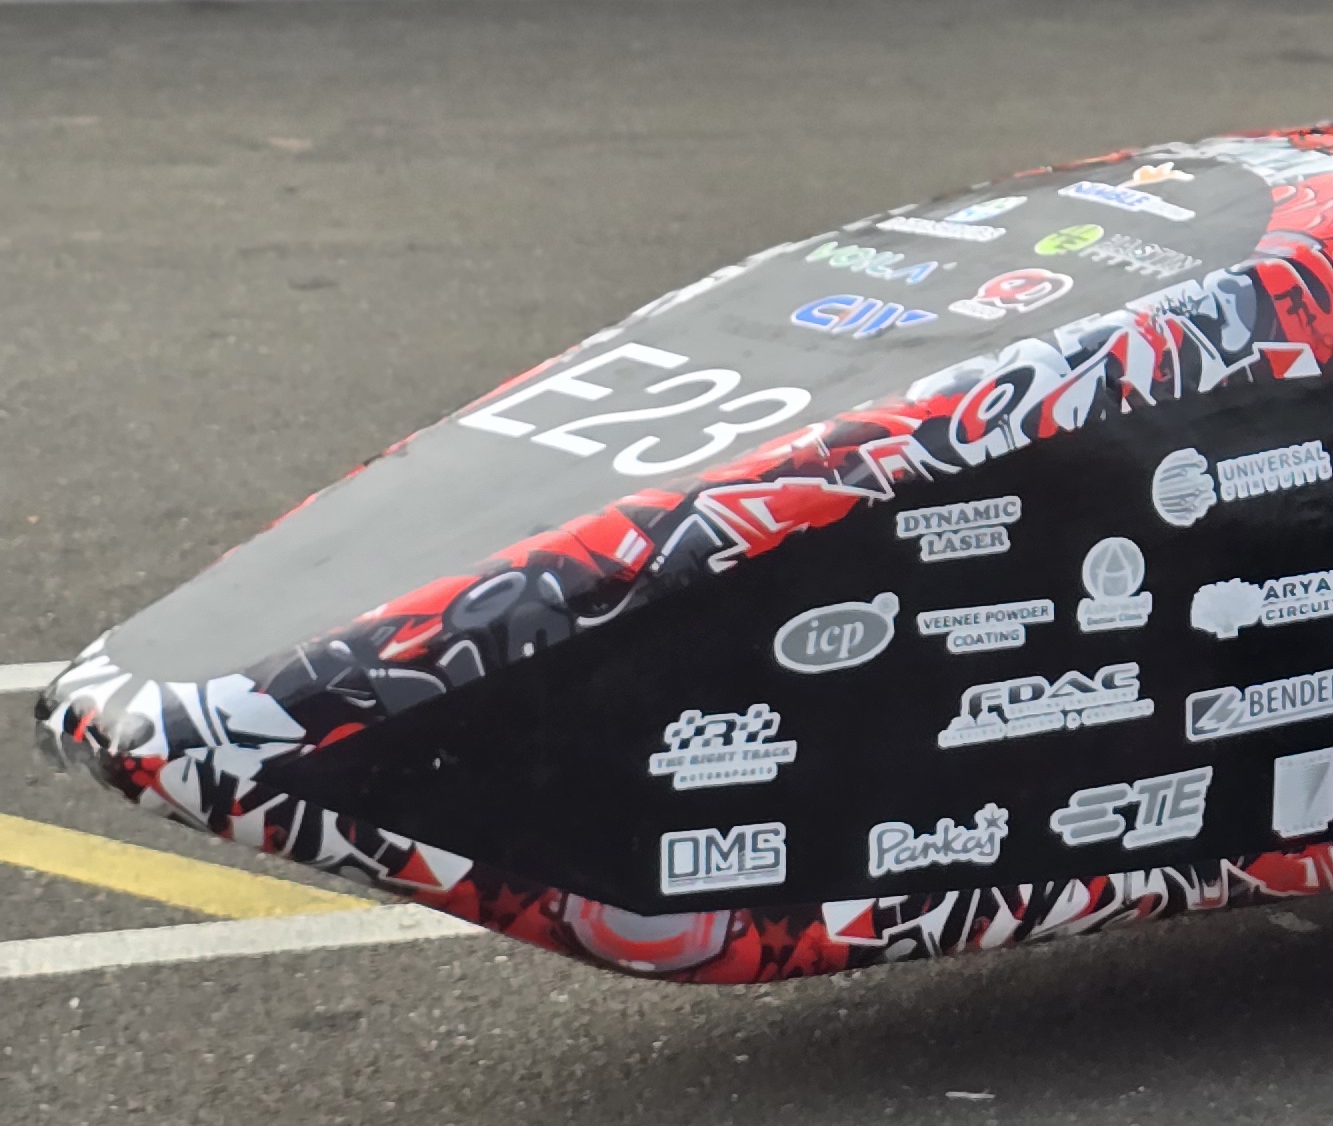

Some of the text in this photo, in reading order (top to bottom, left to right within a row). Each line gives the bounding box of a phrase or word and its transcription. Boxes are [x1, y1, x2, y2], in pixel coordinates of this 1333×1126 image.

[459, 342, 812, 476] E23
[1222, 446, 1327, 481] UNIVERSAL
[902, 500, 1018, 534] DYNAMIC
[926, 530, 1005, 557] LASER
[923, 604, 1050, 630] VEENEE POWDER
[805, 619, 865, 659] icp
[953, 628, 1021, 648] COATING
